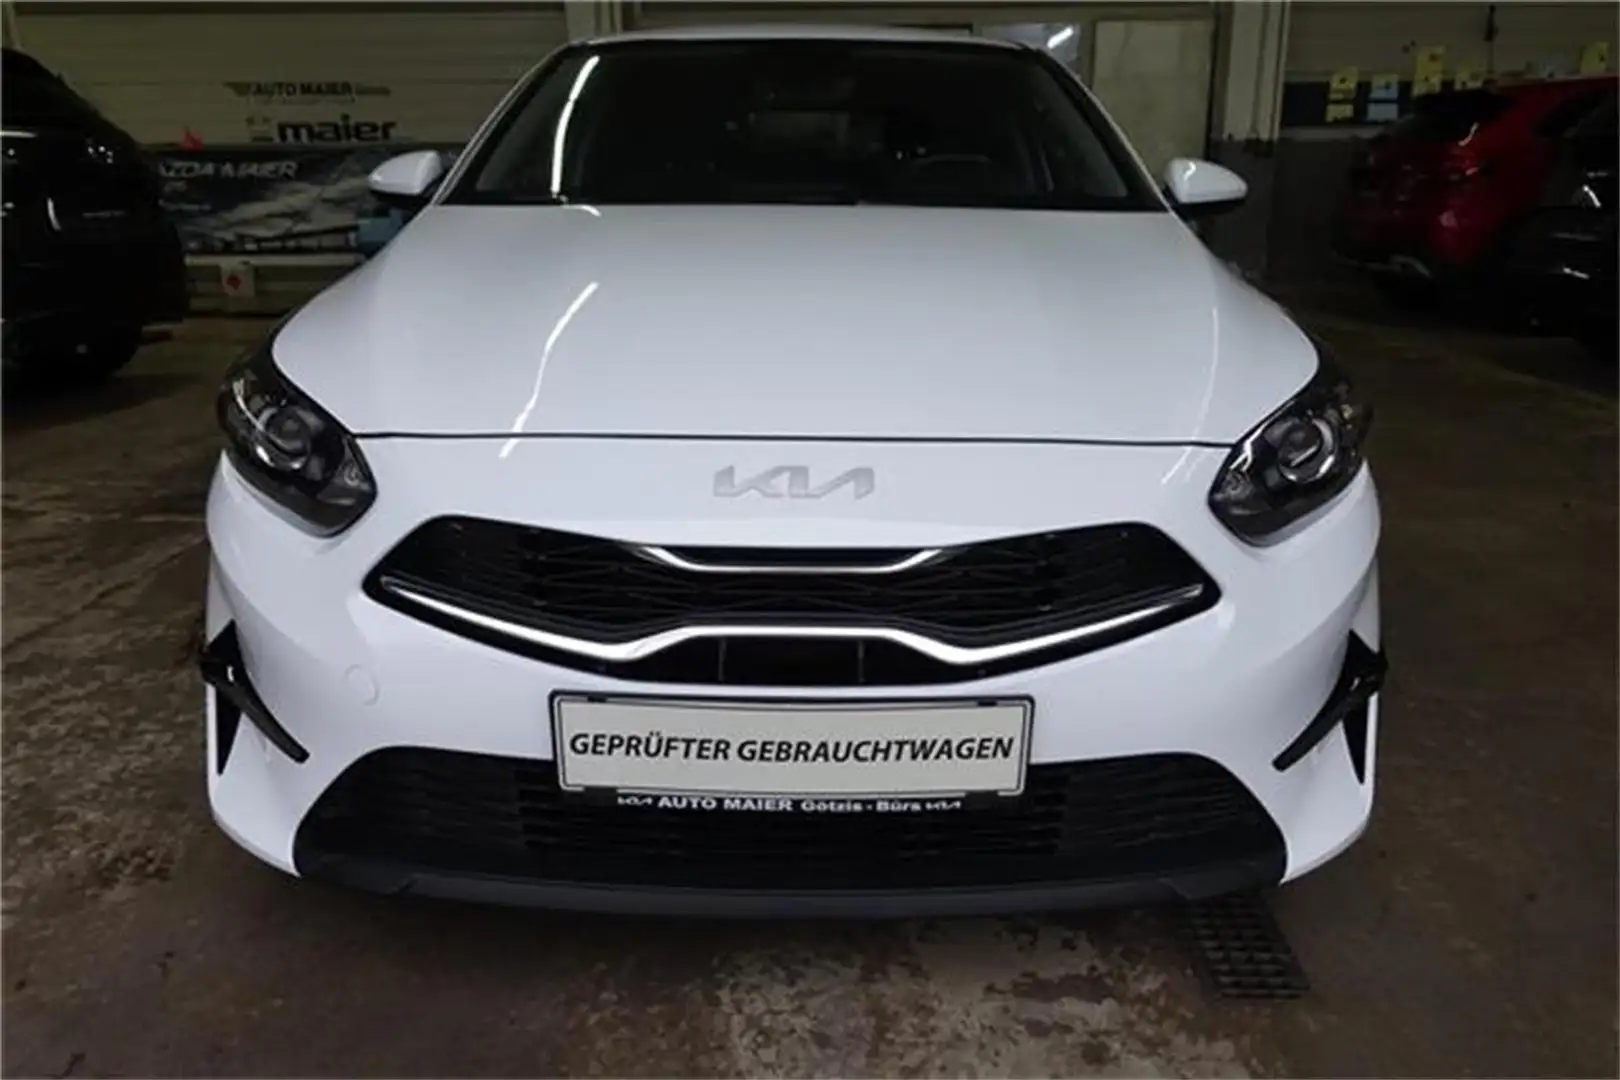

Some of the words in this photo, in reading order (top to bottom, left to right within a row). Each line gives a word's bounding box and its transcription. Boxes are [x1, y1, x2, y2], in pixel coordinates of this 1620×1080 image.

[254, 82, 297, 96] AUTO
[300, 82, 353, 96] MAIER
[277, 113, 396, 143] maier
[220, 161, 297, 179] MAIER
[714, 465, 874, 499] KIA
[570, 731, 730, 761] GEPRÜFTER
[738, 737, 1013, 763] GEBRAUCHTWAGEN
[658, 795, 716, 810] AUTO
[723, 797, 793, 811] MAIER
